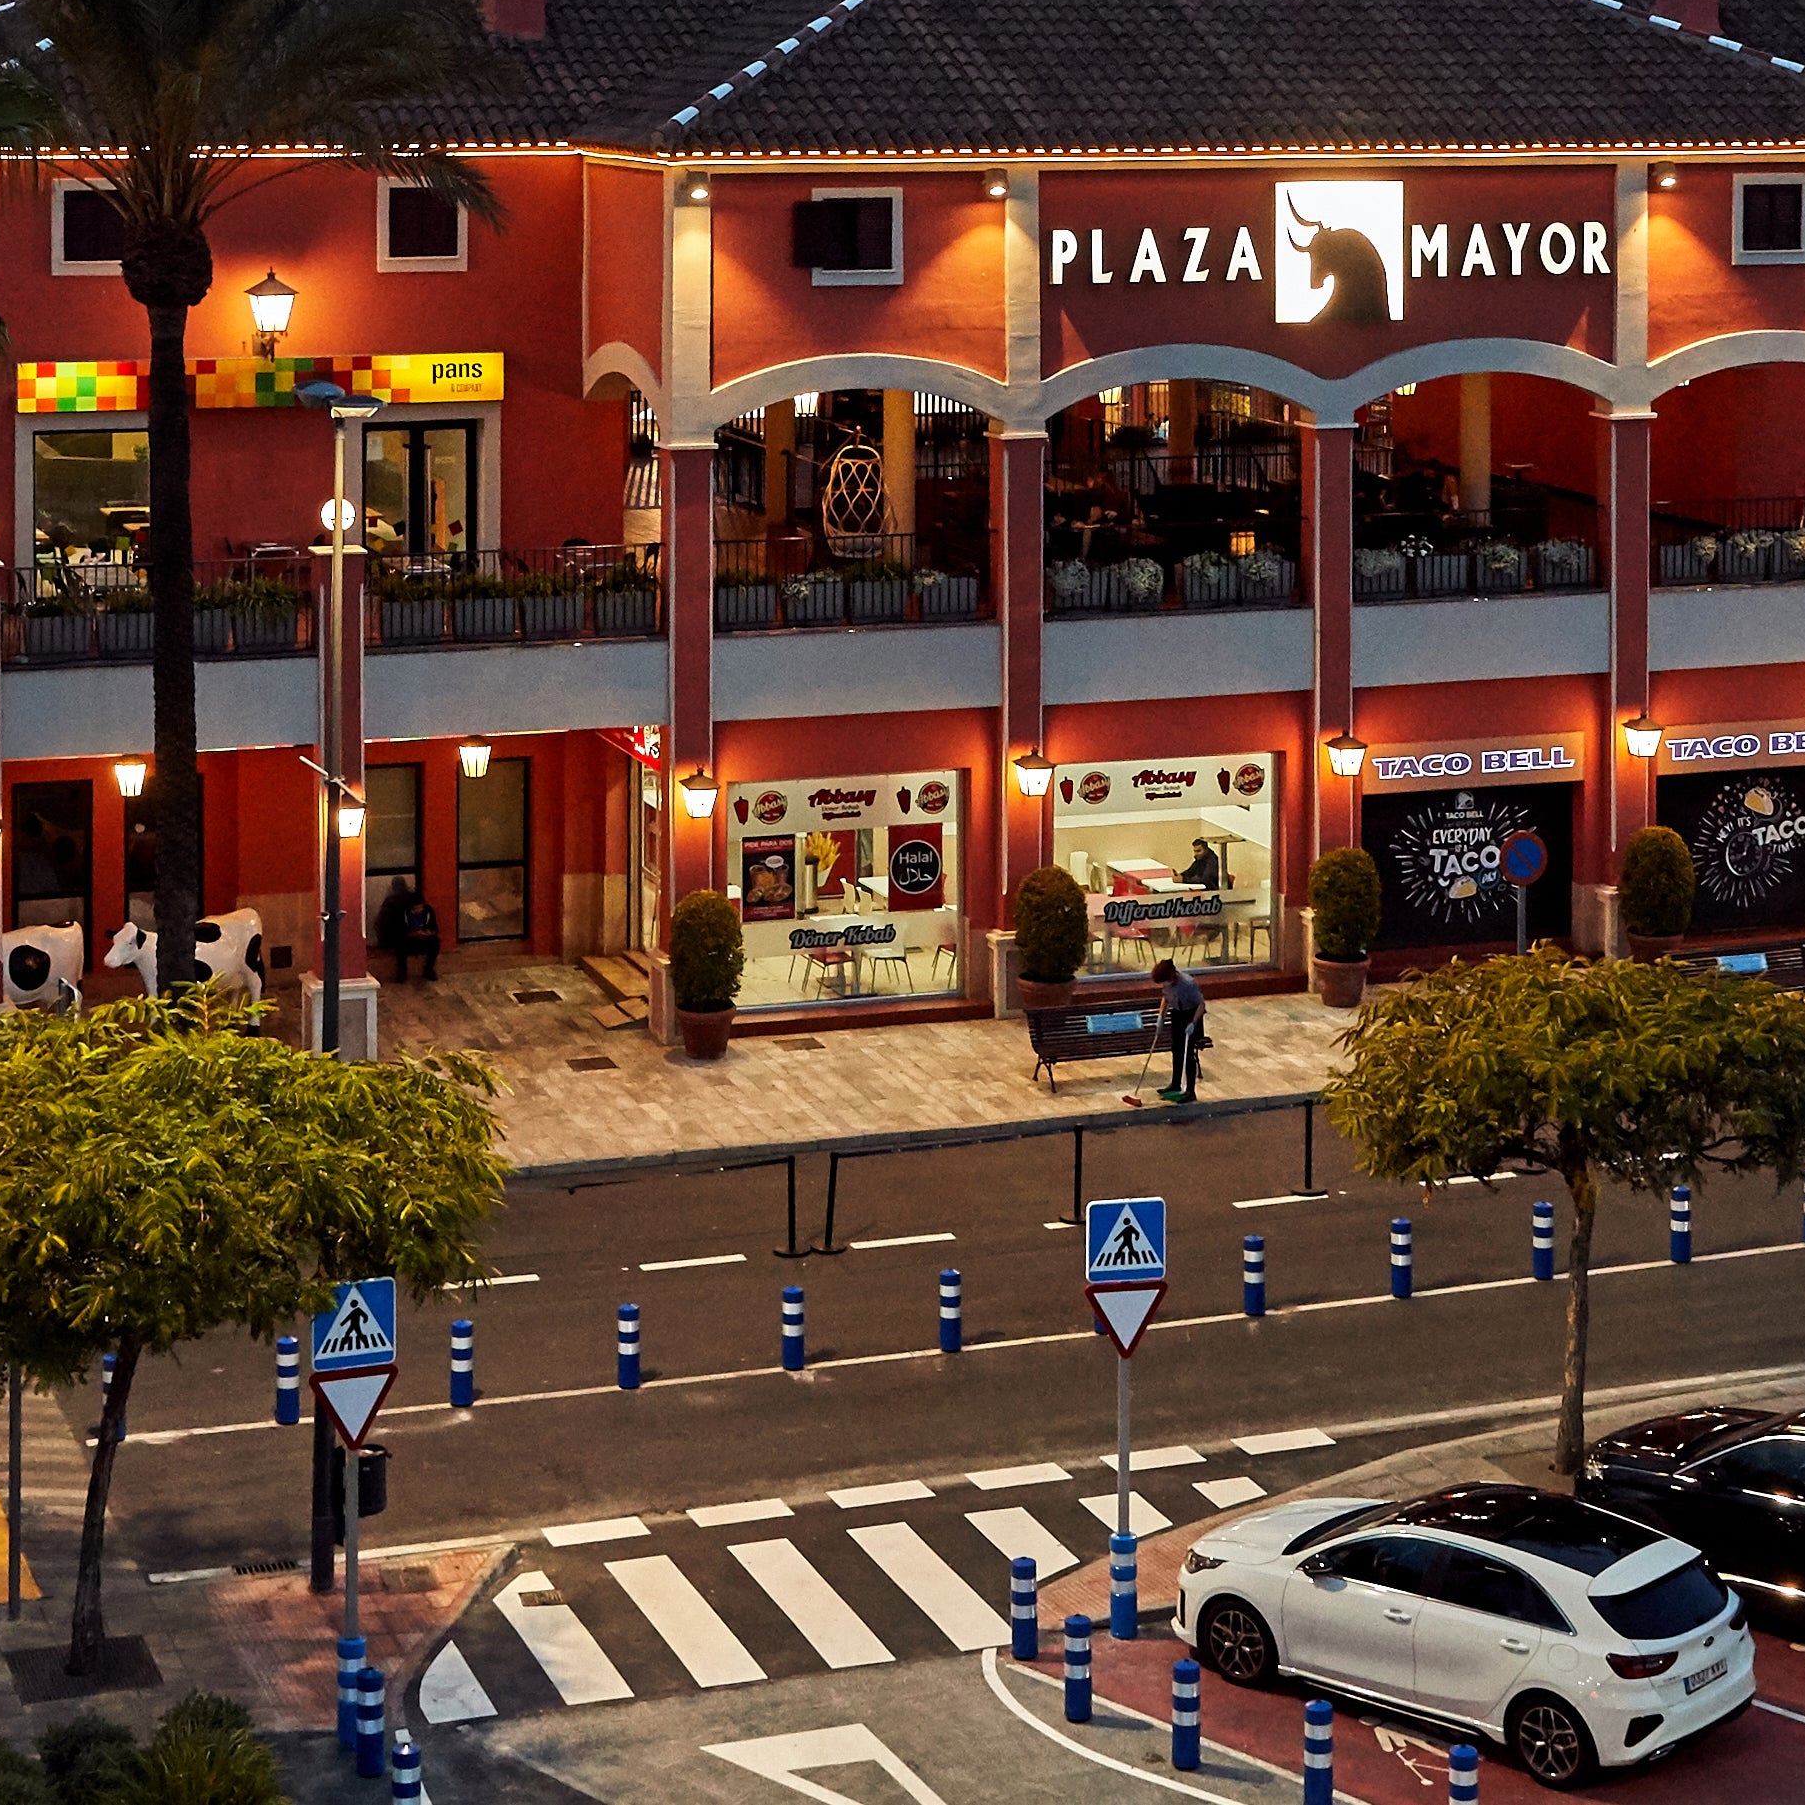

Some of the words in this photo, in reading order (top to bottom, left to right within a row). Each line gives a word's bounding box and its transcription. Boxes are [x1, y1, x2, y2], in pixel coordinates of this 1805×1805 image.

[1050, 226, 1263, 285] PLAZA
[1410, 221, 1612, 279] MAYOR
[431, 362, 483, 384] pans
[1665, 734, 1760, 761] TACO
[1372, 752, 1472, 779] TACO
[1481, 746, 1575, 773] BELL
[1445, 811, 1465, 819] TACO
[1466, 809, 1484, 818] BELL
[1432, 827, 1493, 845] EVERYDAY
[1715, 821, 1734, 843] HEY!
[1737, 815, 1751, 827] IT'S
[898, 850, 934, 865] Halal
[1772, 839, 1796, 853] TIME
[1429, 845, 1500, 876] TACO
[898, 867, 934, 885] حلال
[1104, 896, 1174, 927] Different
[1173, 894, 1222, 916] kebab
[789, 927, 844, 950] Döner
[844, 923, 896, 947] Kebab
